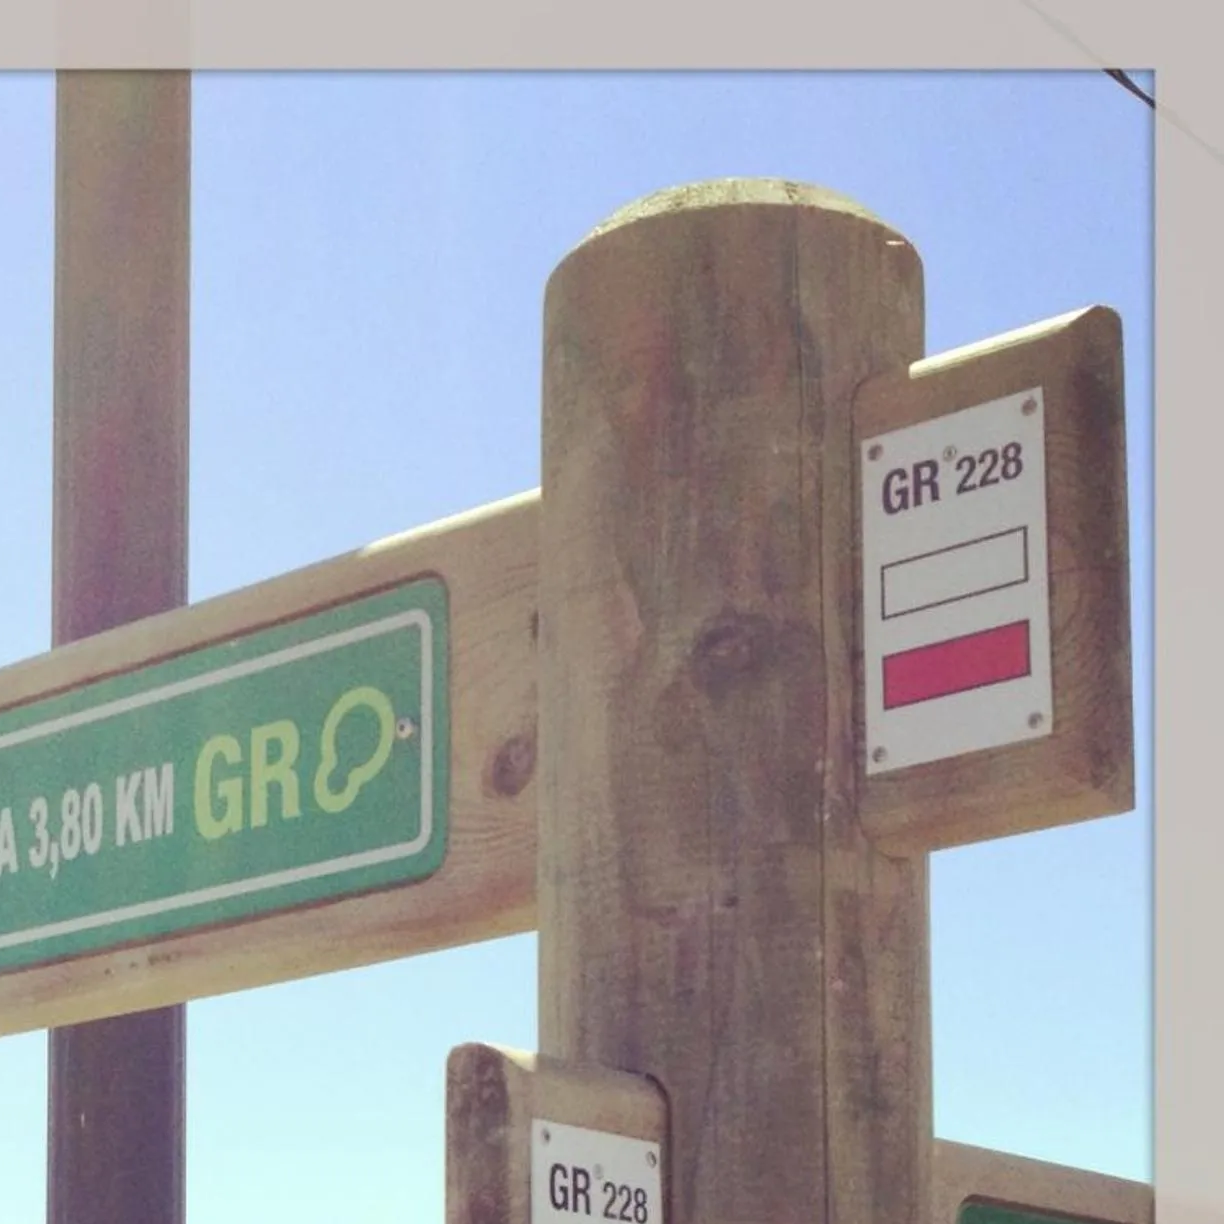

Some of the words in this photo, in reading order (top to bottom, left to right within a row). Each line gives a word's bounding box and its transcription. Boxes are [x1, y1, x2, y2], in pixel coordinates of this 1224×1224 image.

[955, 441, 1024, 495] 228
[28, 782, 103, 878] 3,80
[115, 763, 175, 846] KM
[602, 1181, 648, 1224] 228
